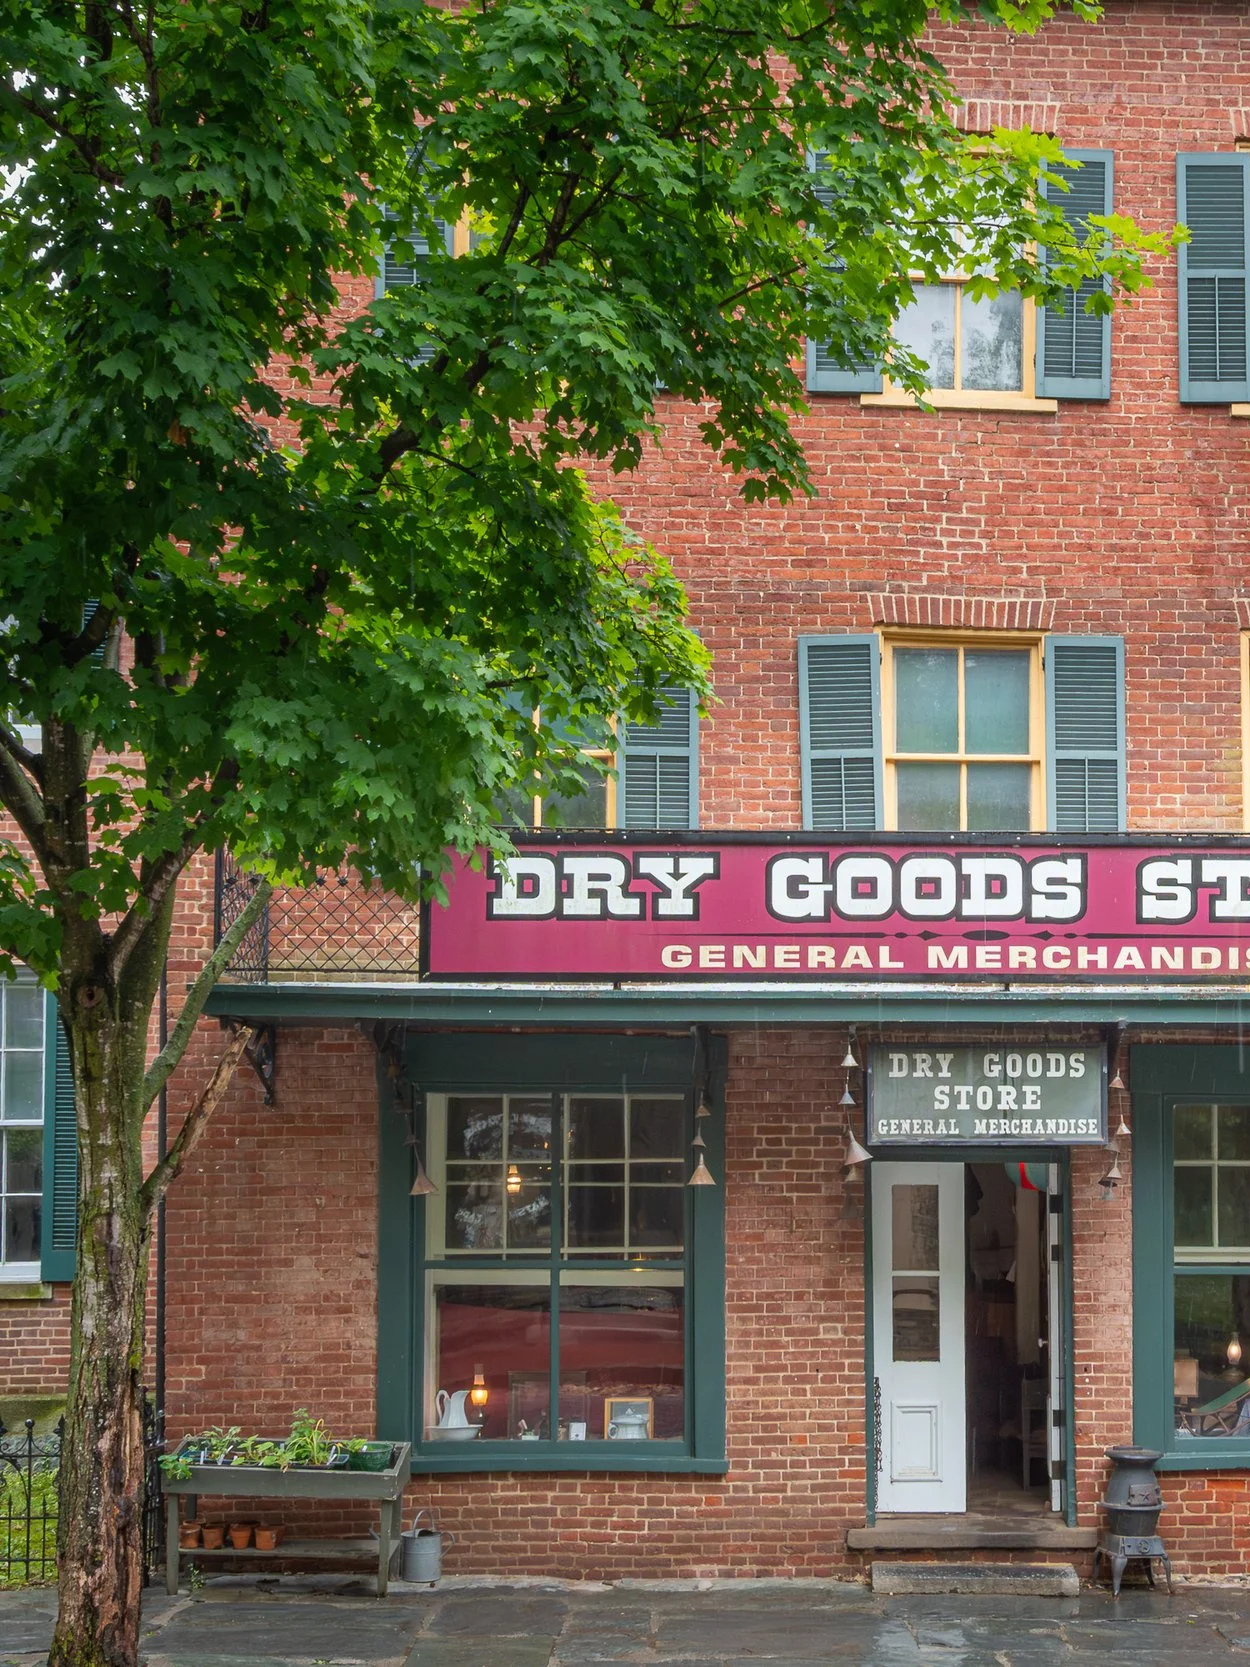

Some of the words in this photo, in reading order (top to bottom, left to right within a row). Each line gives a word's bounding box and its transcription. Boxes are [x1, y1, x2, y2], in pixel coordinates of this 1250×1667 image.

[490, 855, 716, 917] DRY
[770, 856, 1083, 919] GOODS
[660, 943, 904, 969] GENERAL
[888, 1053, 954, 1078] DRY
[983, 1053, 1086, 1078] GOODS
[933, 1085, 1042, 1110] STORE
[878, 1119, 960, 1135] GENERAL
[974, 1119, 1098, 1135] MERCHANDISE
